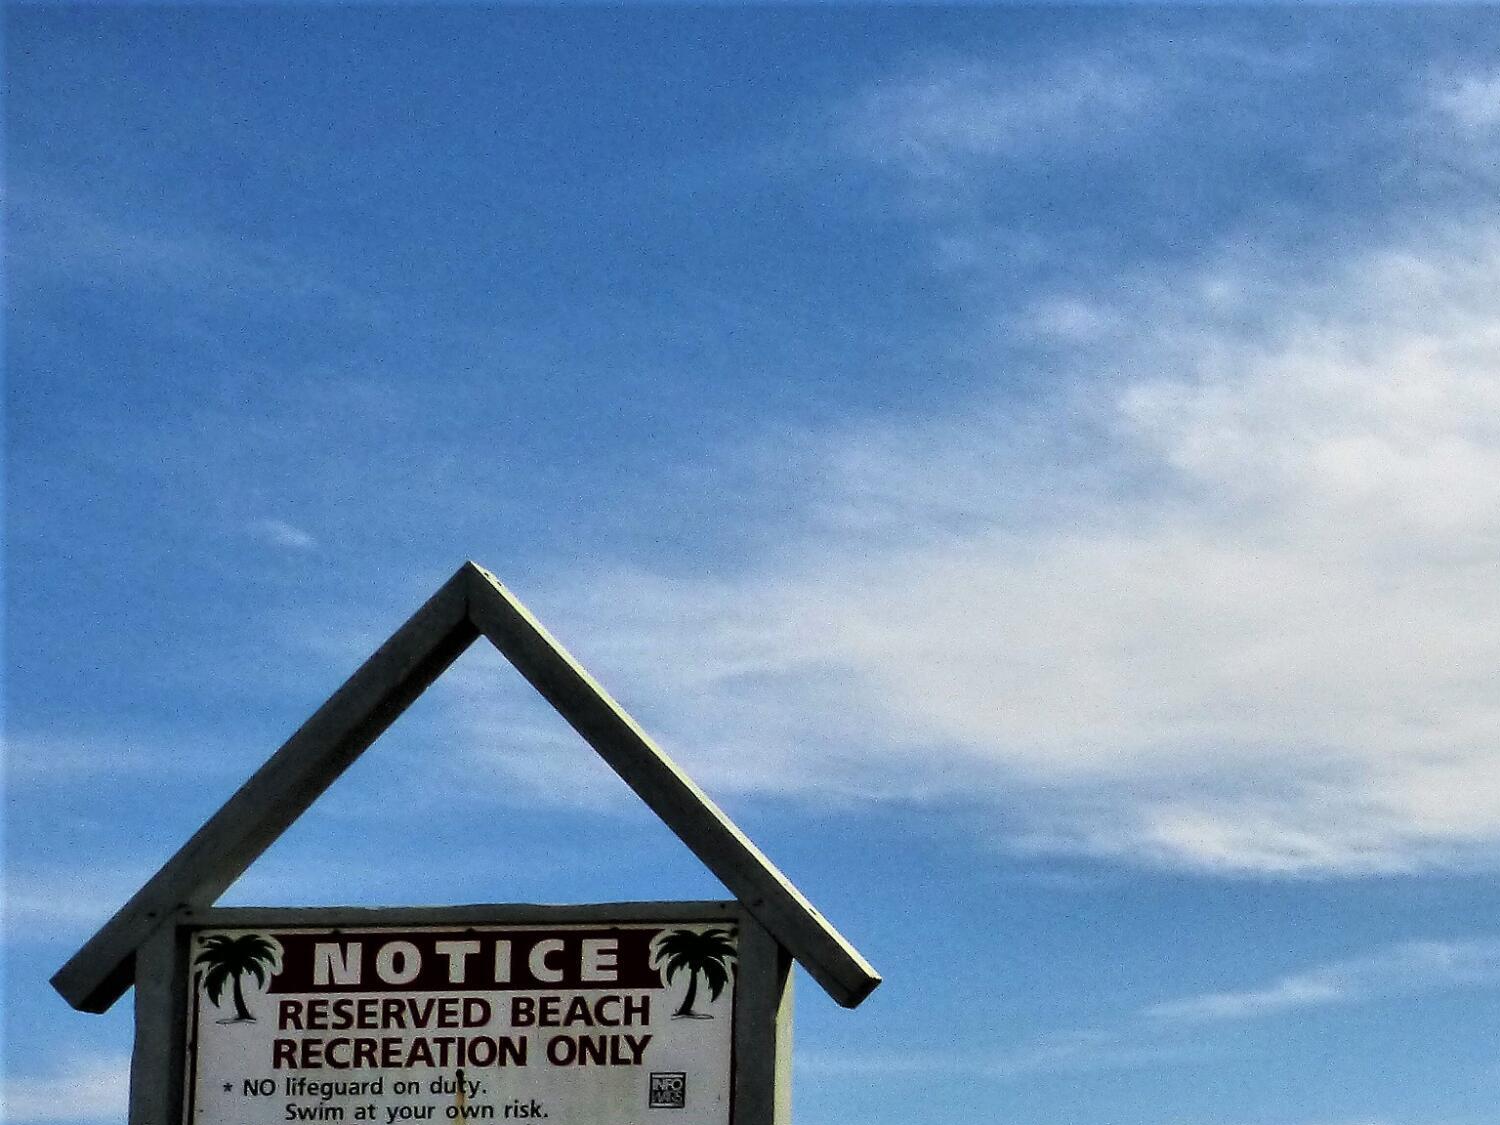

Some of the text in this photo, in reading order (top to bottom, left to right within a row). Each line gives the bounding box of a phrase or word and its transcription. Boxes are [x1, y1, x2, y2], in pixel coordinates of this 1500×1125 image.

[313, 939, 618, 985] NOTICE
[278, 995, 650, 1030] RESERVED BEACH
[273, 1034, 653, 1069] RECREATION ONLY
[244, 1076, 486, 1100] NO lifeguard on duty.
[285, 1100, 549, 1124] Swim at your own risk.
